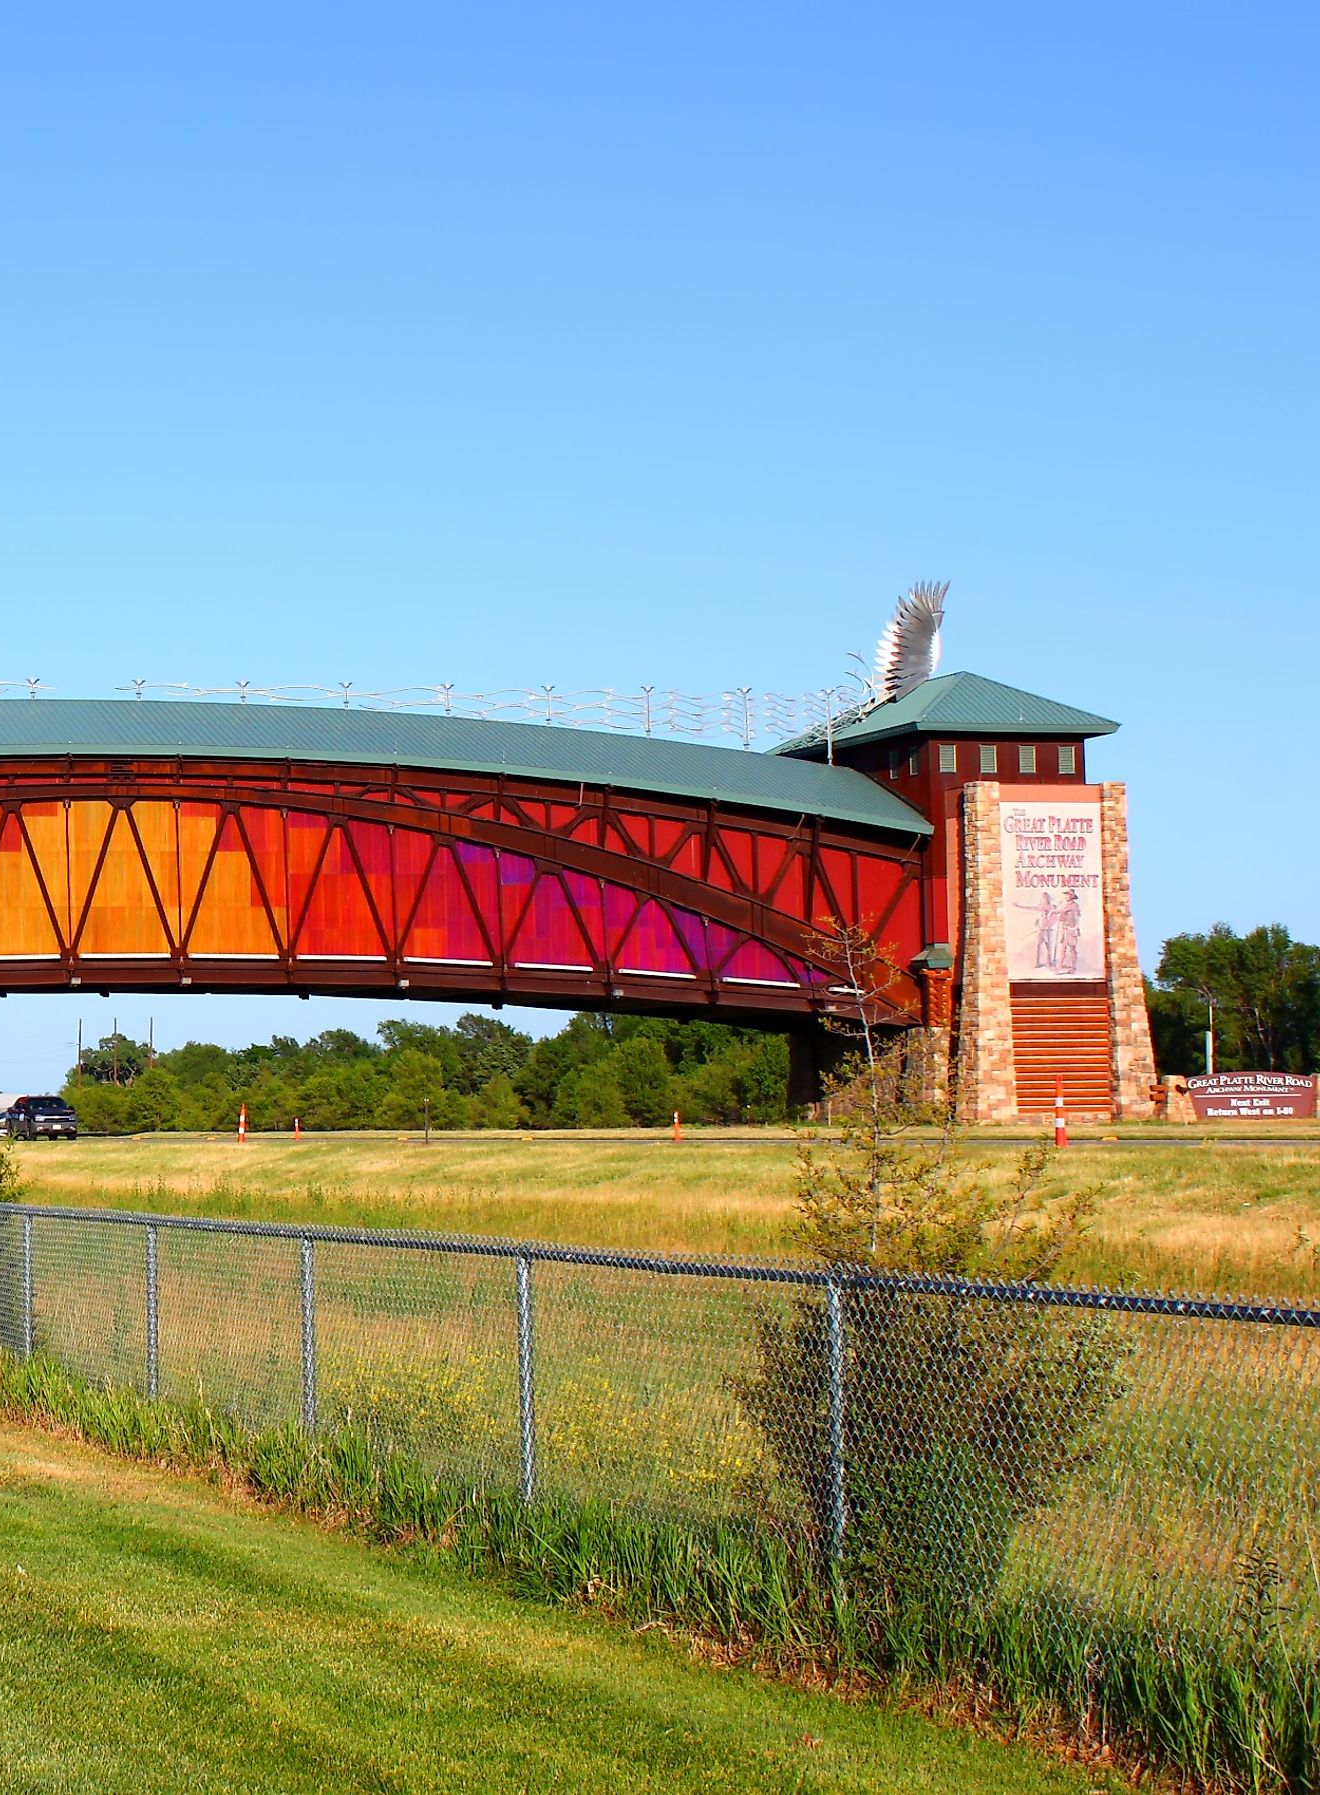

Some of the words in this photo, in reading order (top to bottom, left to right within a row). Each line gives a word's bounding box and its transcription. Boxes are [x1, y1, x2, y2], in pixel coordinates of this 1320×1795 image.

[1003, 815, 1046, 833] GREAT
[1048, 815, 1093, 833] PLATTE
[1015, 834, 1052, 851] RIVER
[1053, 834, 1087, 851] ROAD
[1014, 852, 1084, 868] ARCHWAY
[1015, 870, 1099, 888] MONUMENT
[1188, 1078, 1220, 1089] GREAT
[1219, 1075, 1255, 1086] PLATTE
[1256, 1074, 1284, 1087] RIVER
[1285, 1075, 1313, 1088] ROAD
[1205, 1085, 1242, 1094] ARCHWAY
[1243, 1084, 1290, 1093] MONUMENT
[1230, 1099, 1250, 1107] Next
[1253, 1098, 1270, 1107] Exit
[1207, 1107, 1237, 1116] Return
[1239, 1107, 1260, 1116] West
[1276, 1107, 1293, 1115] I-80
